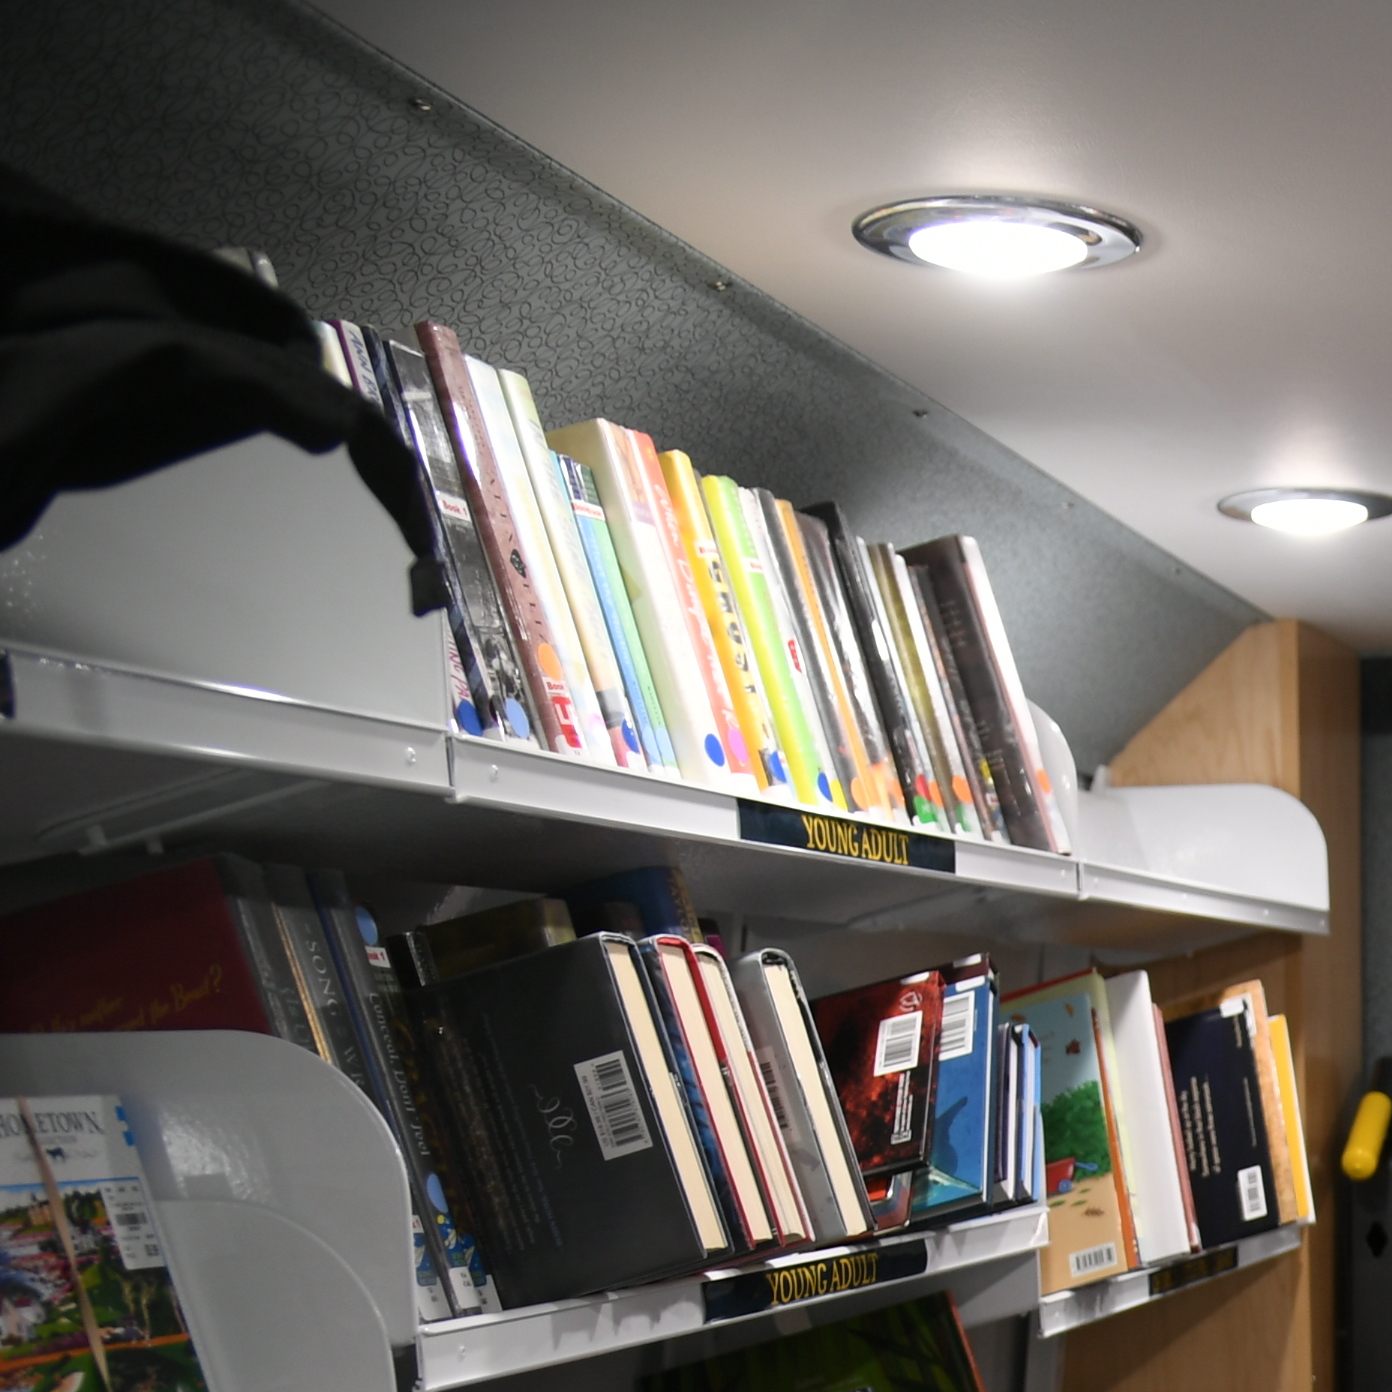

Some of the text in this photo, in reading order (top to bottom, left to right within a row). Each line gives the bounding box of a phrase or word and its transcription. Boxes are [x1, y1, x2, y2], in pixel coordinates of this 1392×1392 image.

[801, 815, 909, 865] YOUNG ADULT
[766, 1252, 878, 1305] YOUNG ADULT
